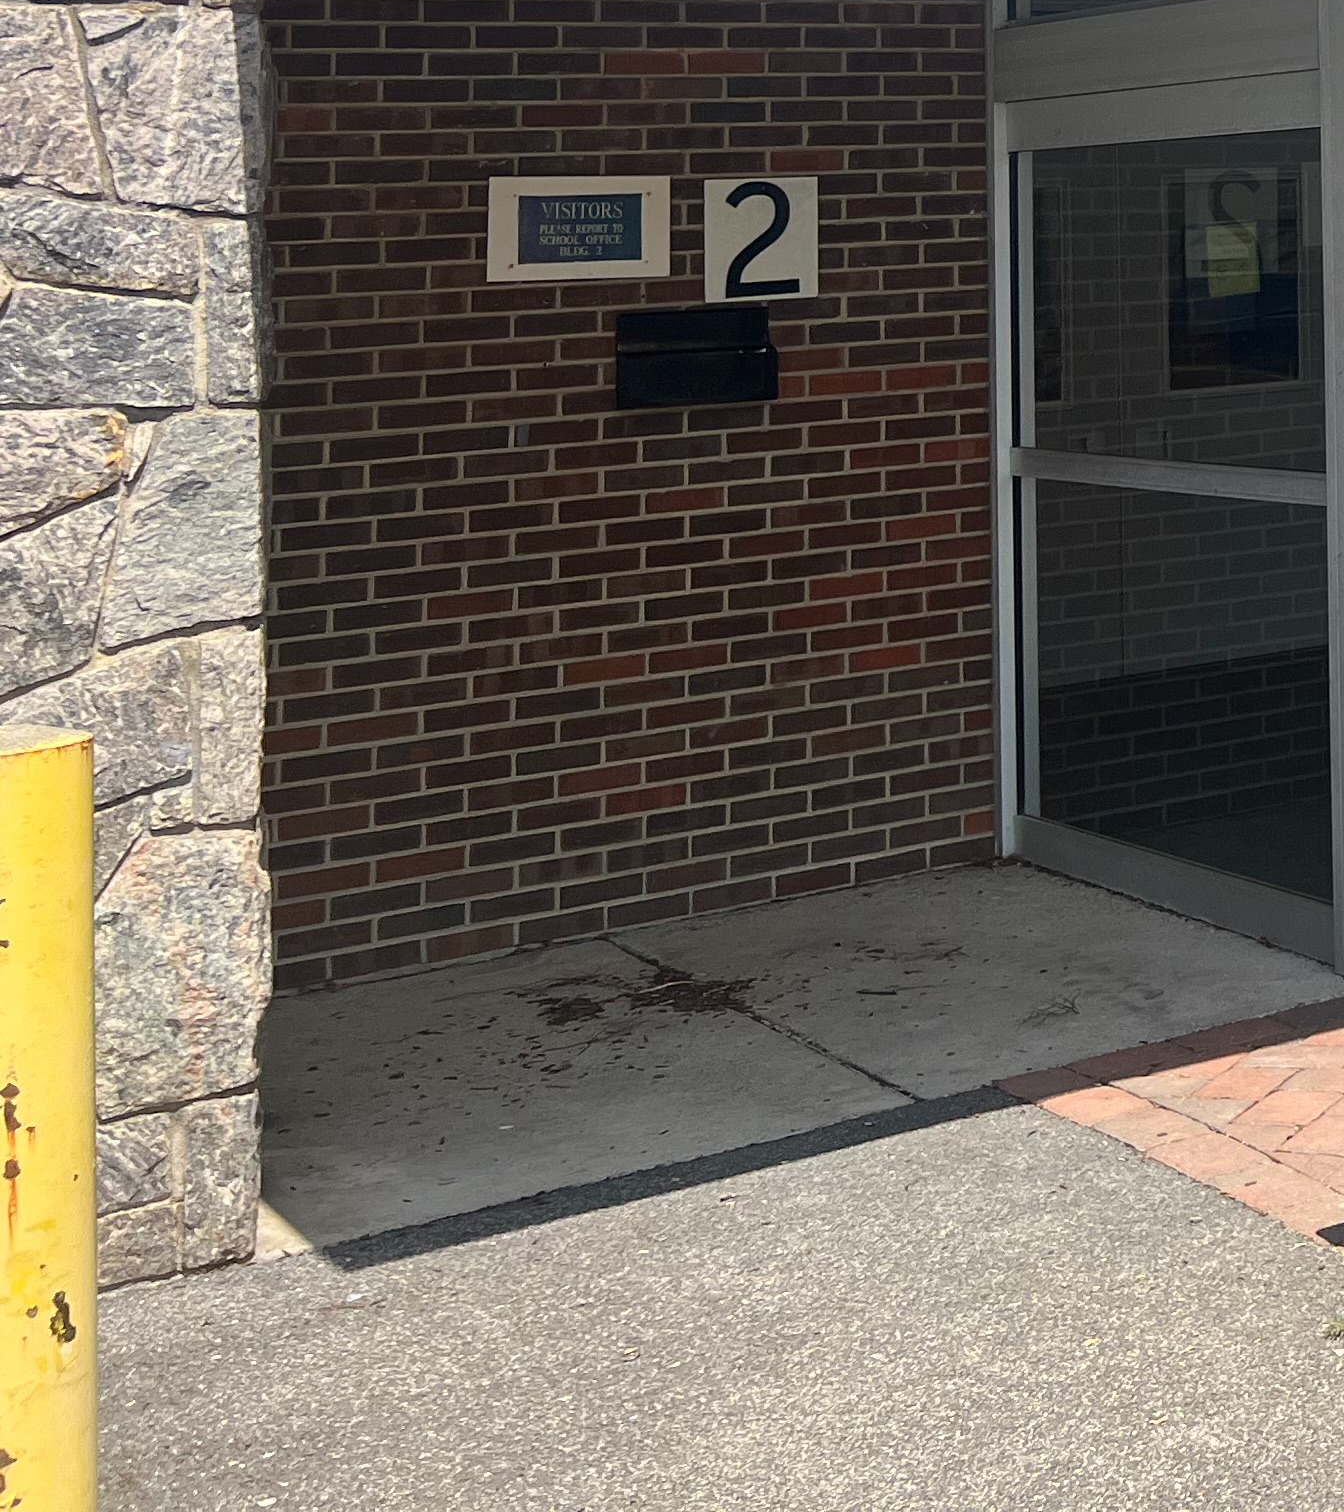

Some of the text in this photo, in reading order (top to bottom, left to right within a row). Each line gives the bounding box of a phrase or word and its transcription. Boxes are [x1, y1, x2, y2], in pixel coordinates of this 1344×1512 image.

[540, 201, 624, 219] VISITORS
[540, 223, 624, 235] PLEASE REPORT TO
[539, 234, 623, 245] SCHOOL OFFICE
[725, 181, 801, 299] 2
